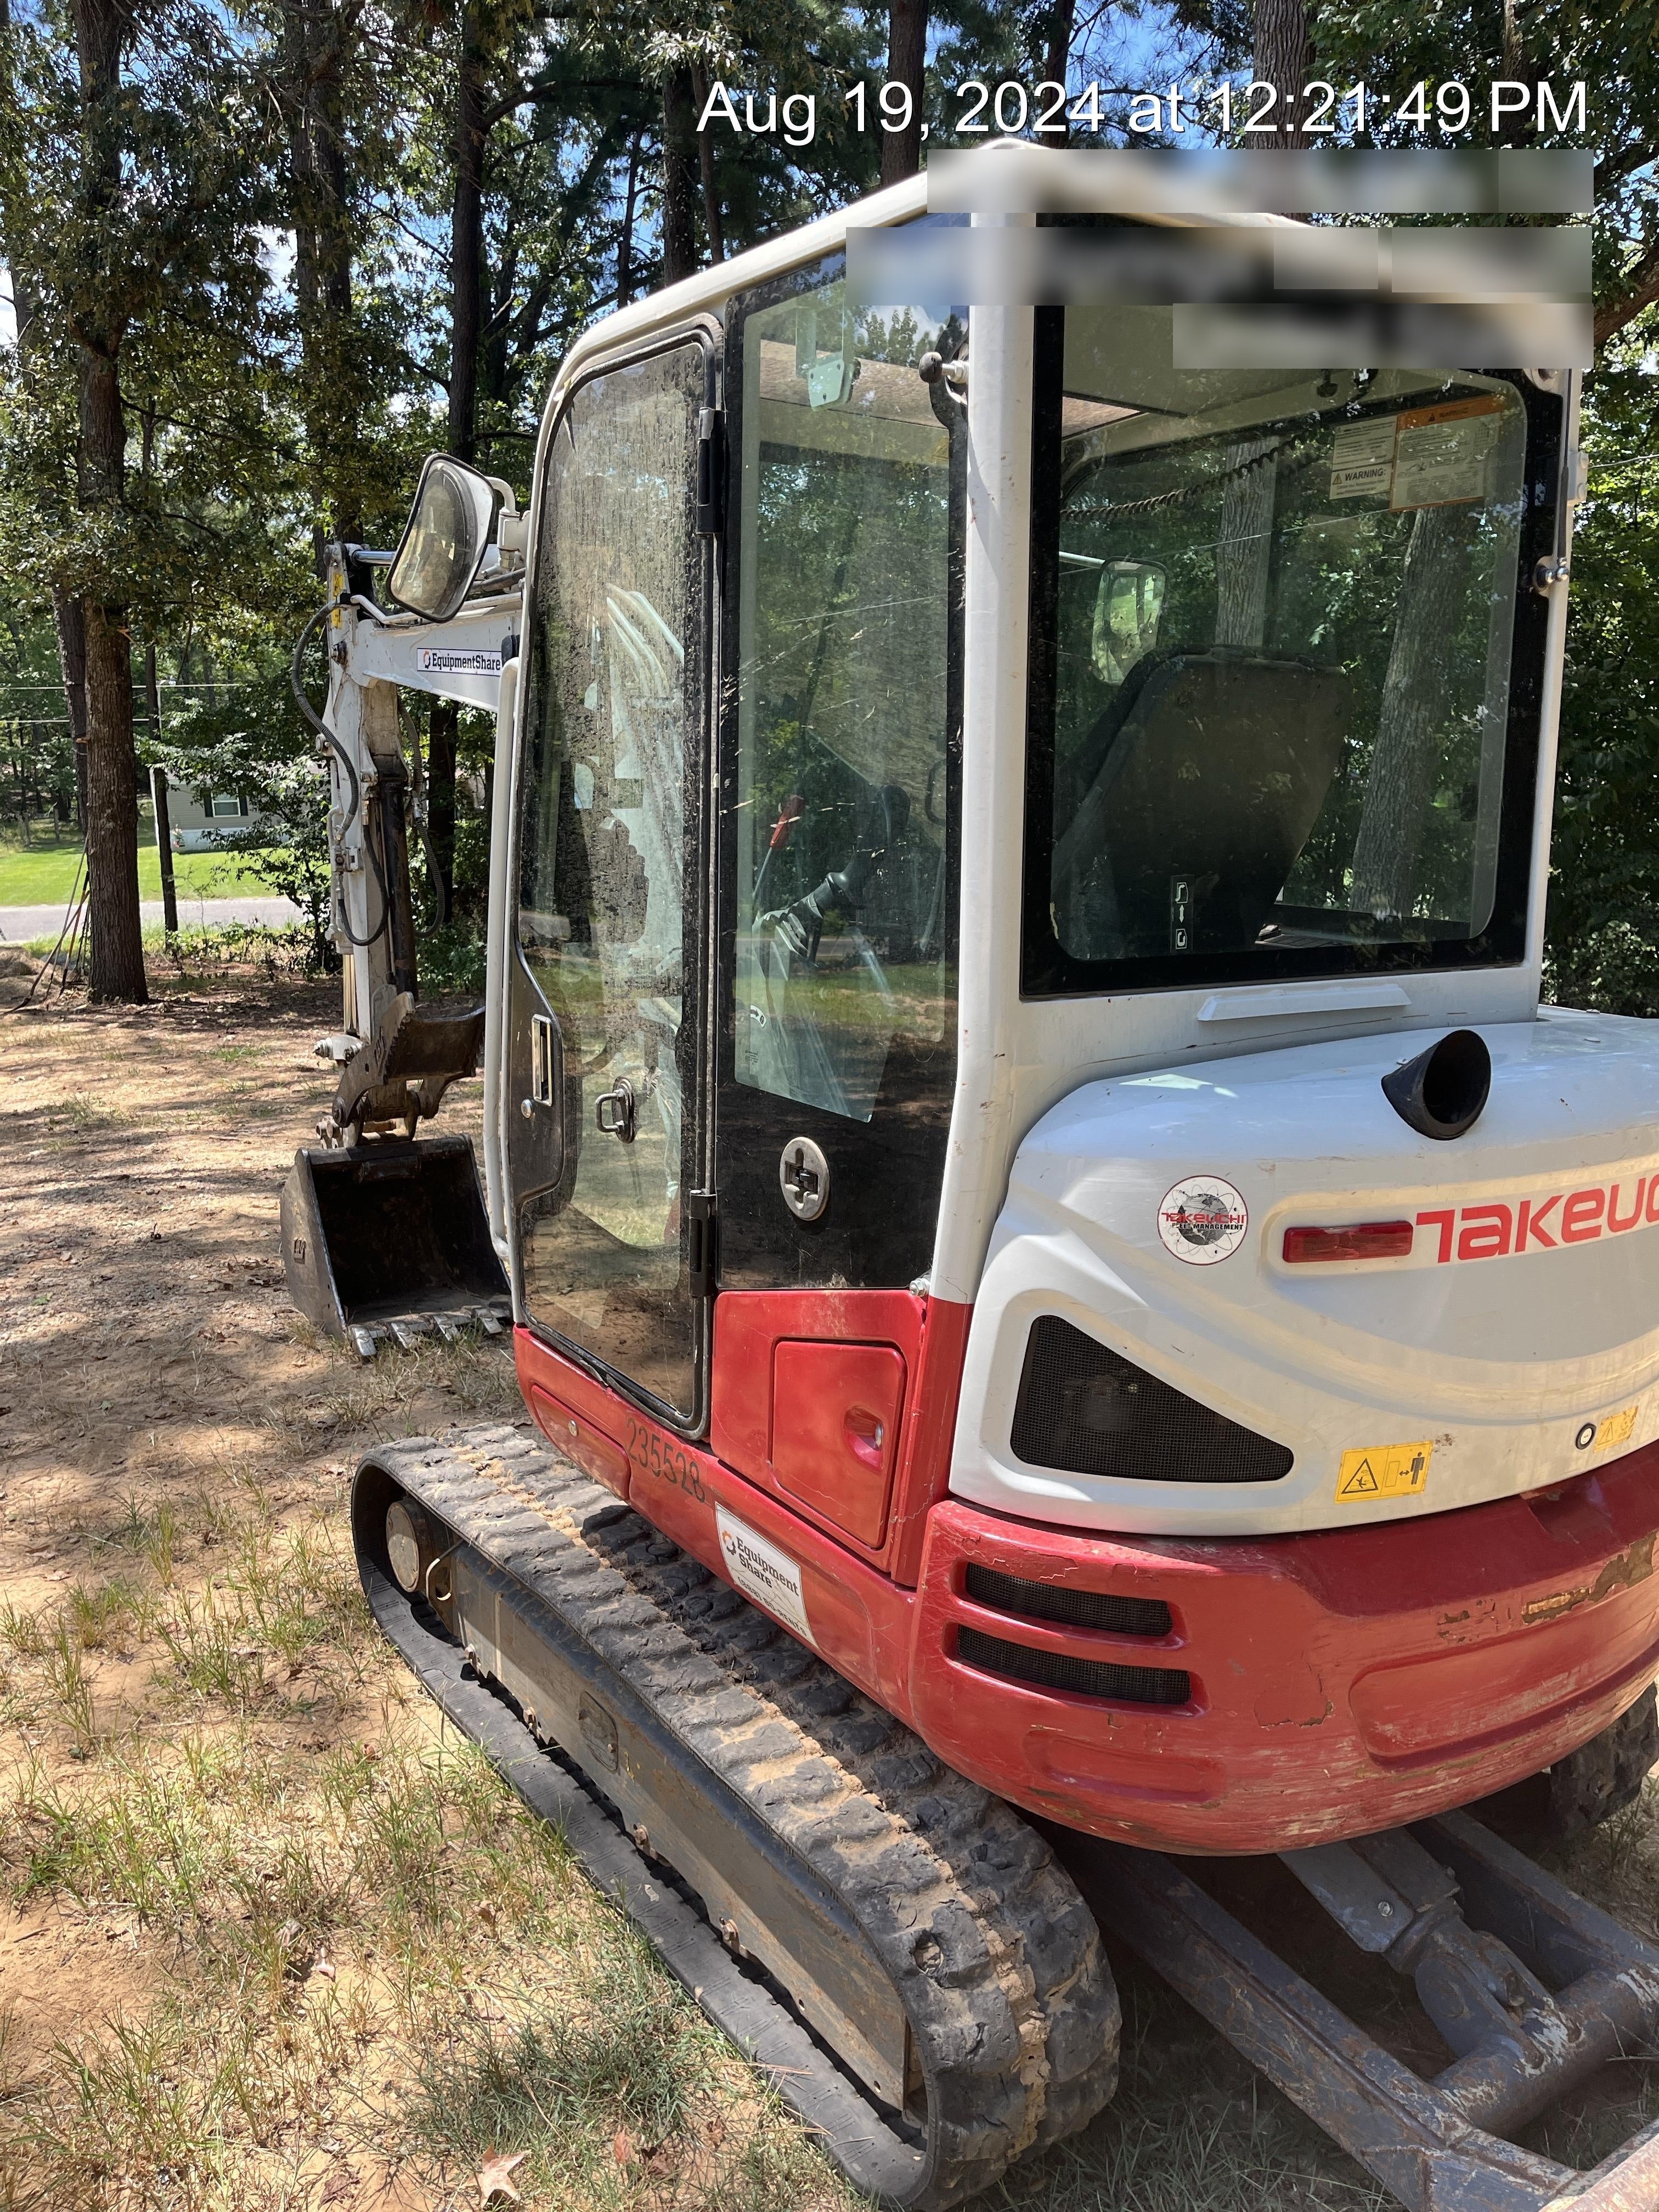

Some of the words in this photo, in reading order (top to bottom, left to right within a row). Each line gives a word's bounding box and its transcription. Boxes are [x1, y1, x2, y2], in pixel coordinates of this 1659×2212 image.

[1345, 467, 1386, 481] WARNING:
[432, 653, 501, 671] EquipmentShare
[626, 1417, 706, 1504] 235528
[736, 1536, 799, 1596] Equipment
[739, 1554, 772, 1589] Share
